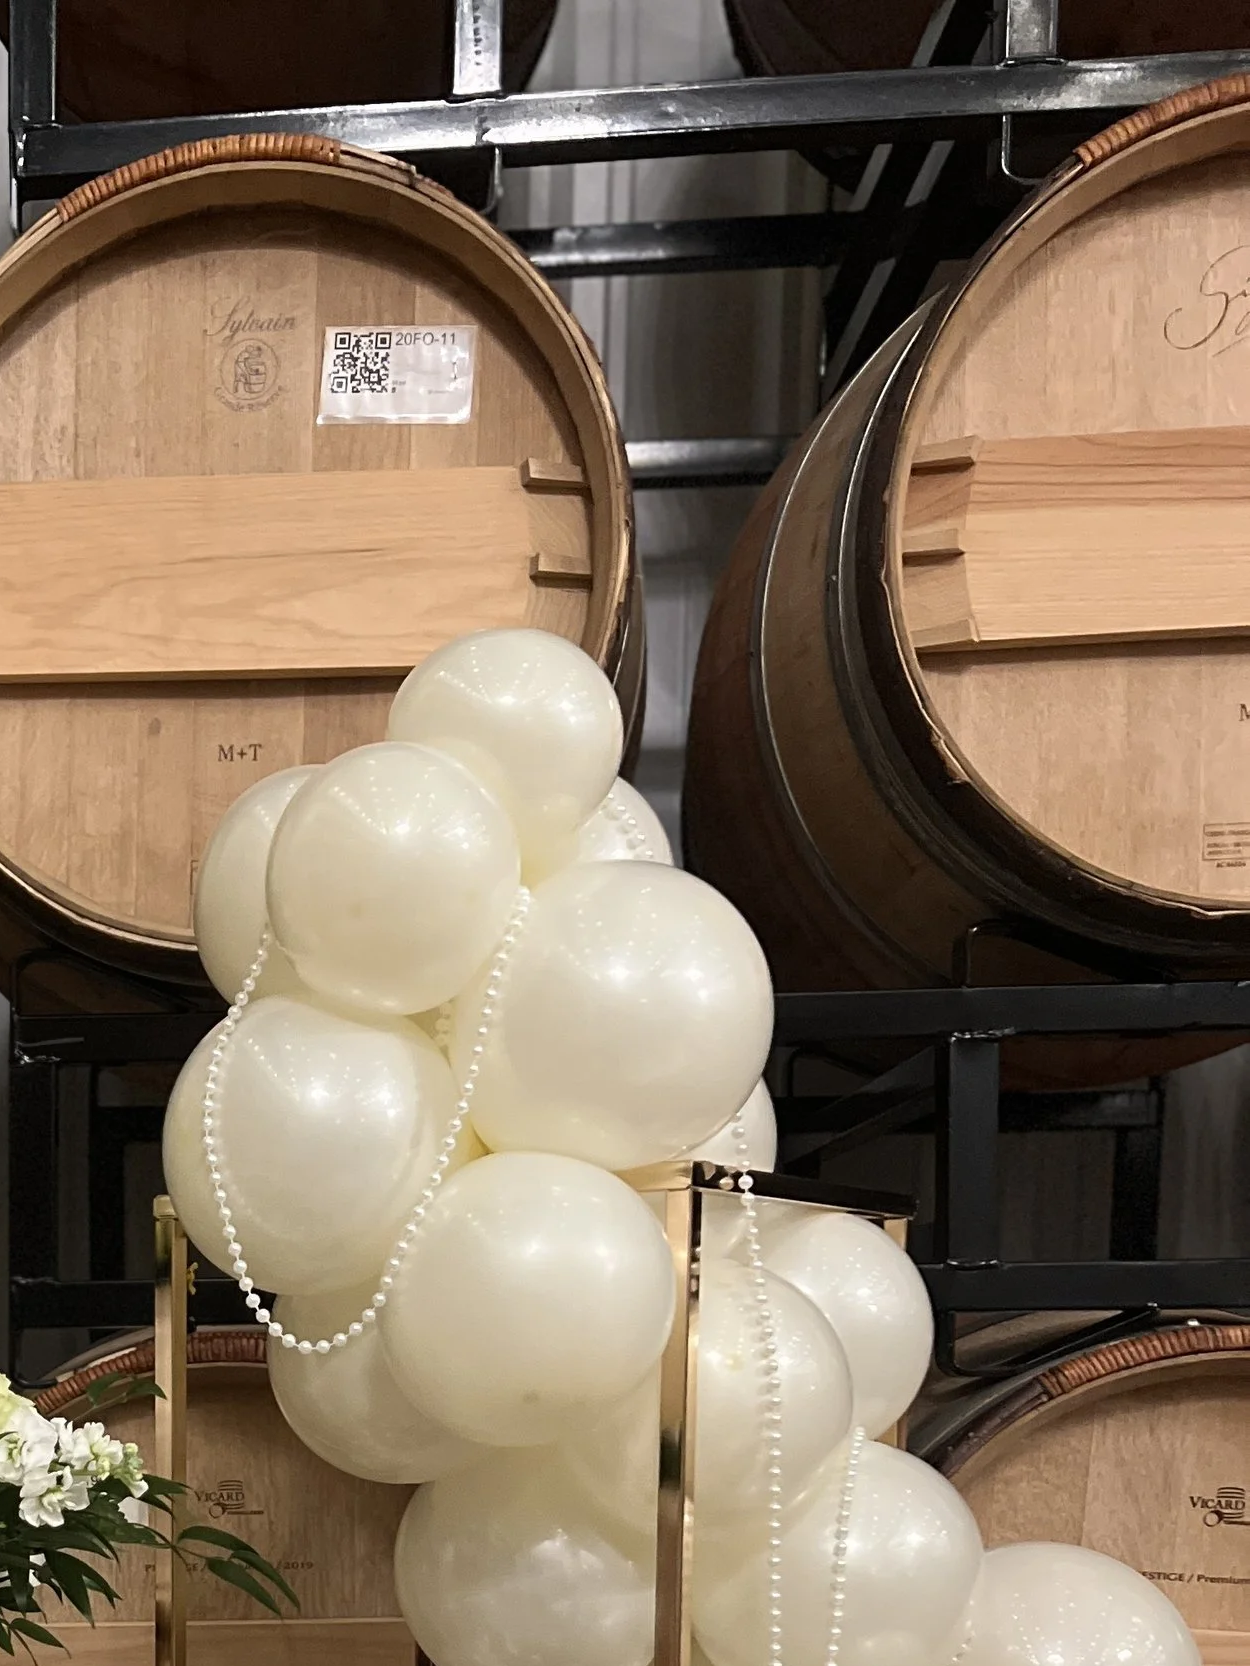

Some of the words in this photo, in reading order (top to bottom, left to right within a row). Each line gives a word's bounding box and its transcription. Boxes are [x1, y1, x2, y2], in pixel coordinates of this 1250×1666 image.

[203, 296, 295, 344] Sylvain
[395, 332, 456, 346] 20FO-11
[218, 743, 263, 762] M+T
[195, 1490, 245, 1504] VICARD
[1189, 1496, 1246, 1510] VICARD
[1141, 1571, 1184, 1582] ESTIGE
